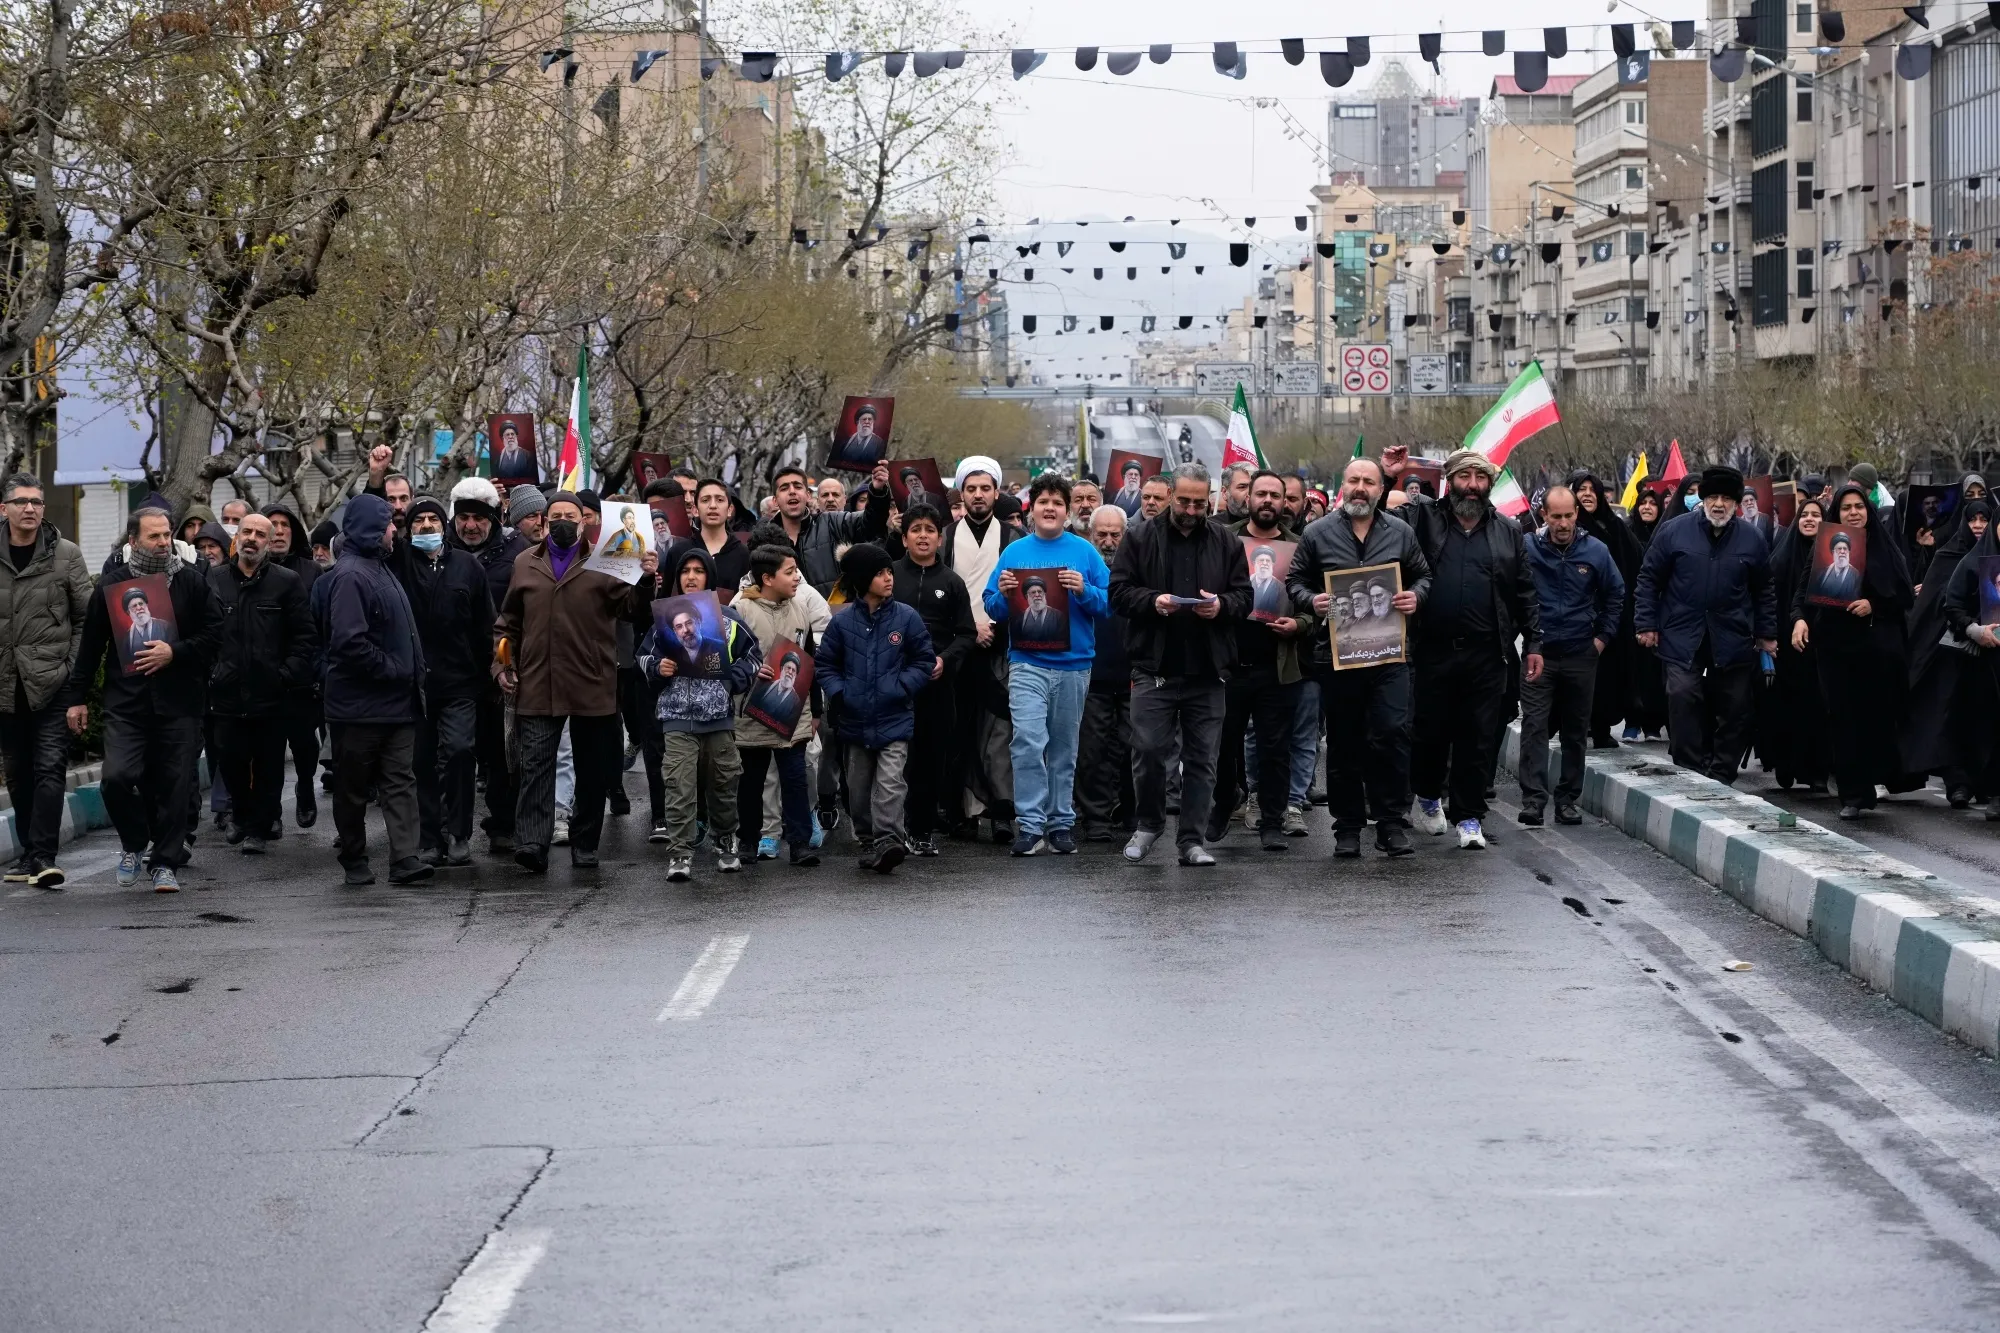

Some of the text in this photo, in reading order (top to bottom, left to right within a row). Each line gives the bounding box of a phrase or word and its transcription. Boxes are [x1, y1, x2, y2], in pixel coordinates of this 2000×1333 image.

[1339, 644, 1402, 660] فتح قدس نزدیک است
